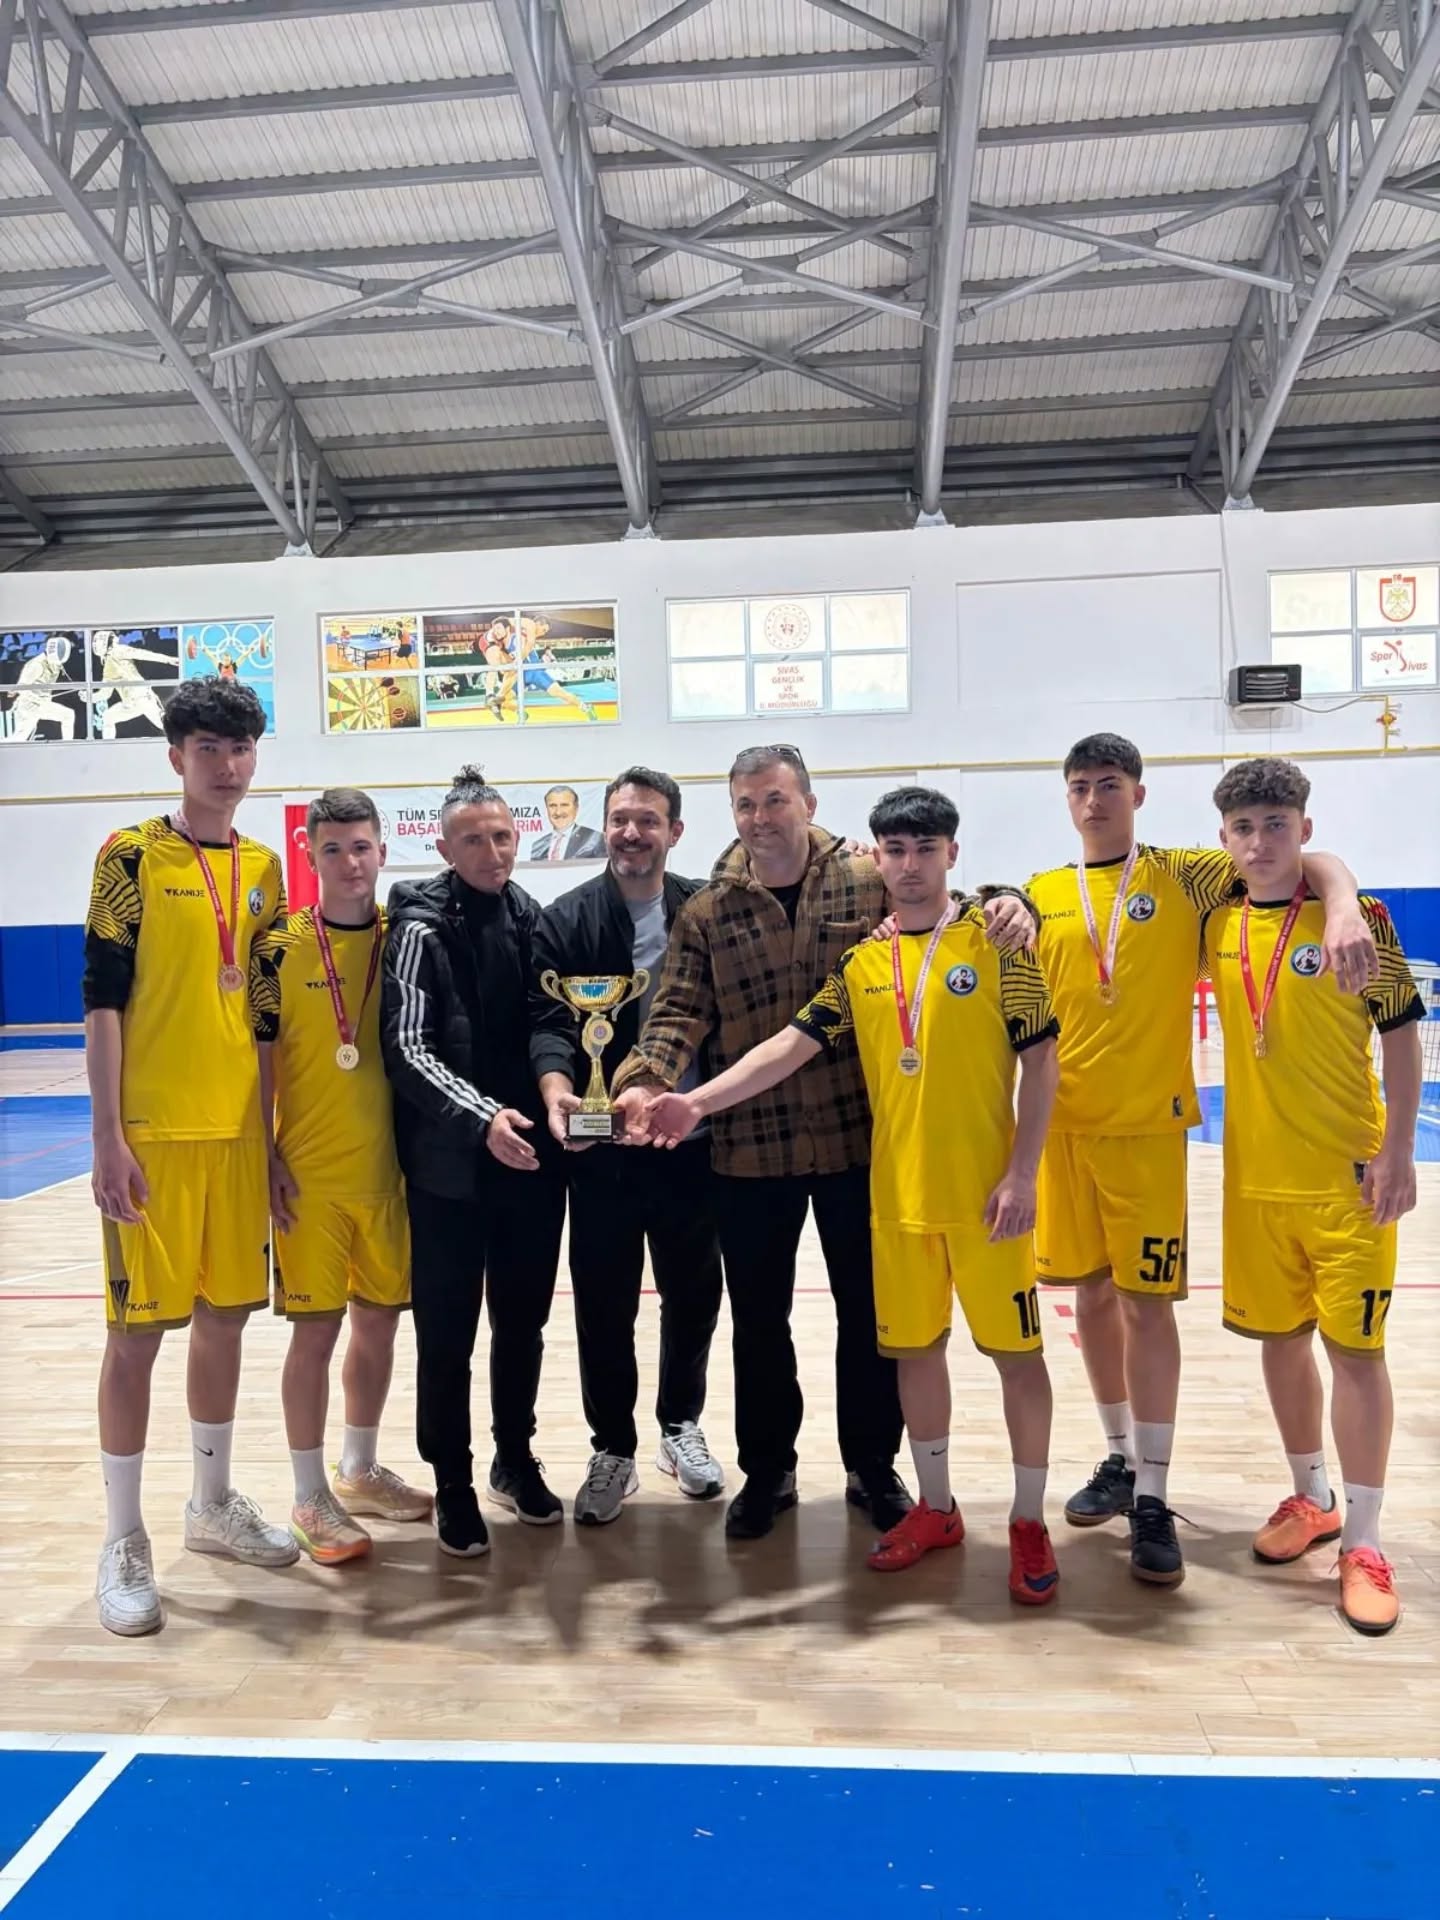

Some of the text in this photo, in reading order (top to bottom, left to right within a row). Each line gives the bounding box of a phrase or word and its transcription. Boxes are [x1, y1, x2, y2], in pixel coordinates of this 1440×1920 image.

[396, 808, 426, 821] TÜM
[1140, 1236, 1180, 1282] 58
[1012, 1286, 1041, 1339] 10
[1361, 1289, 1393, 1337] 17
